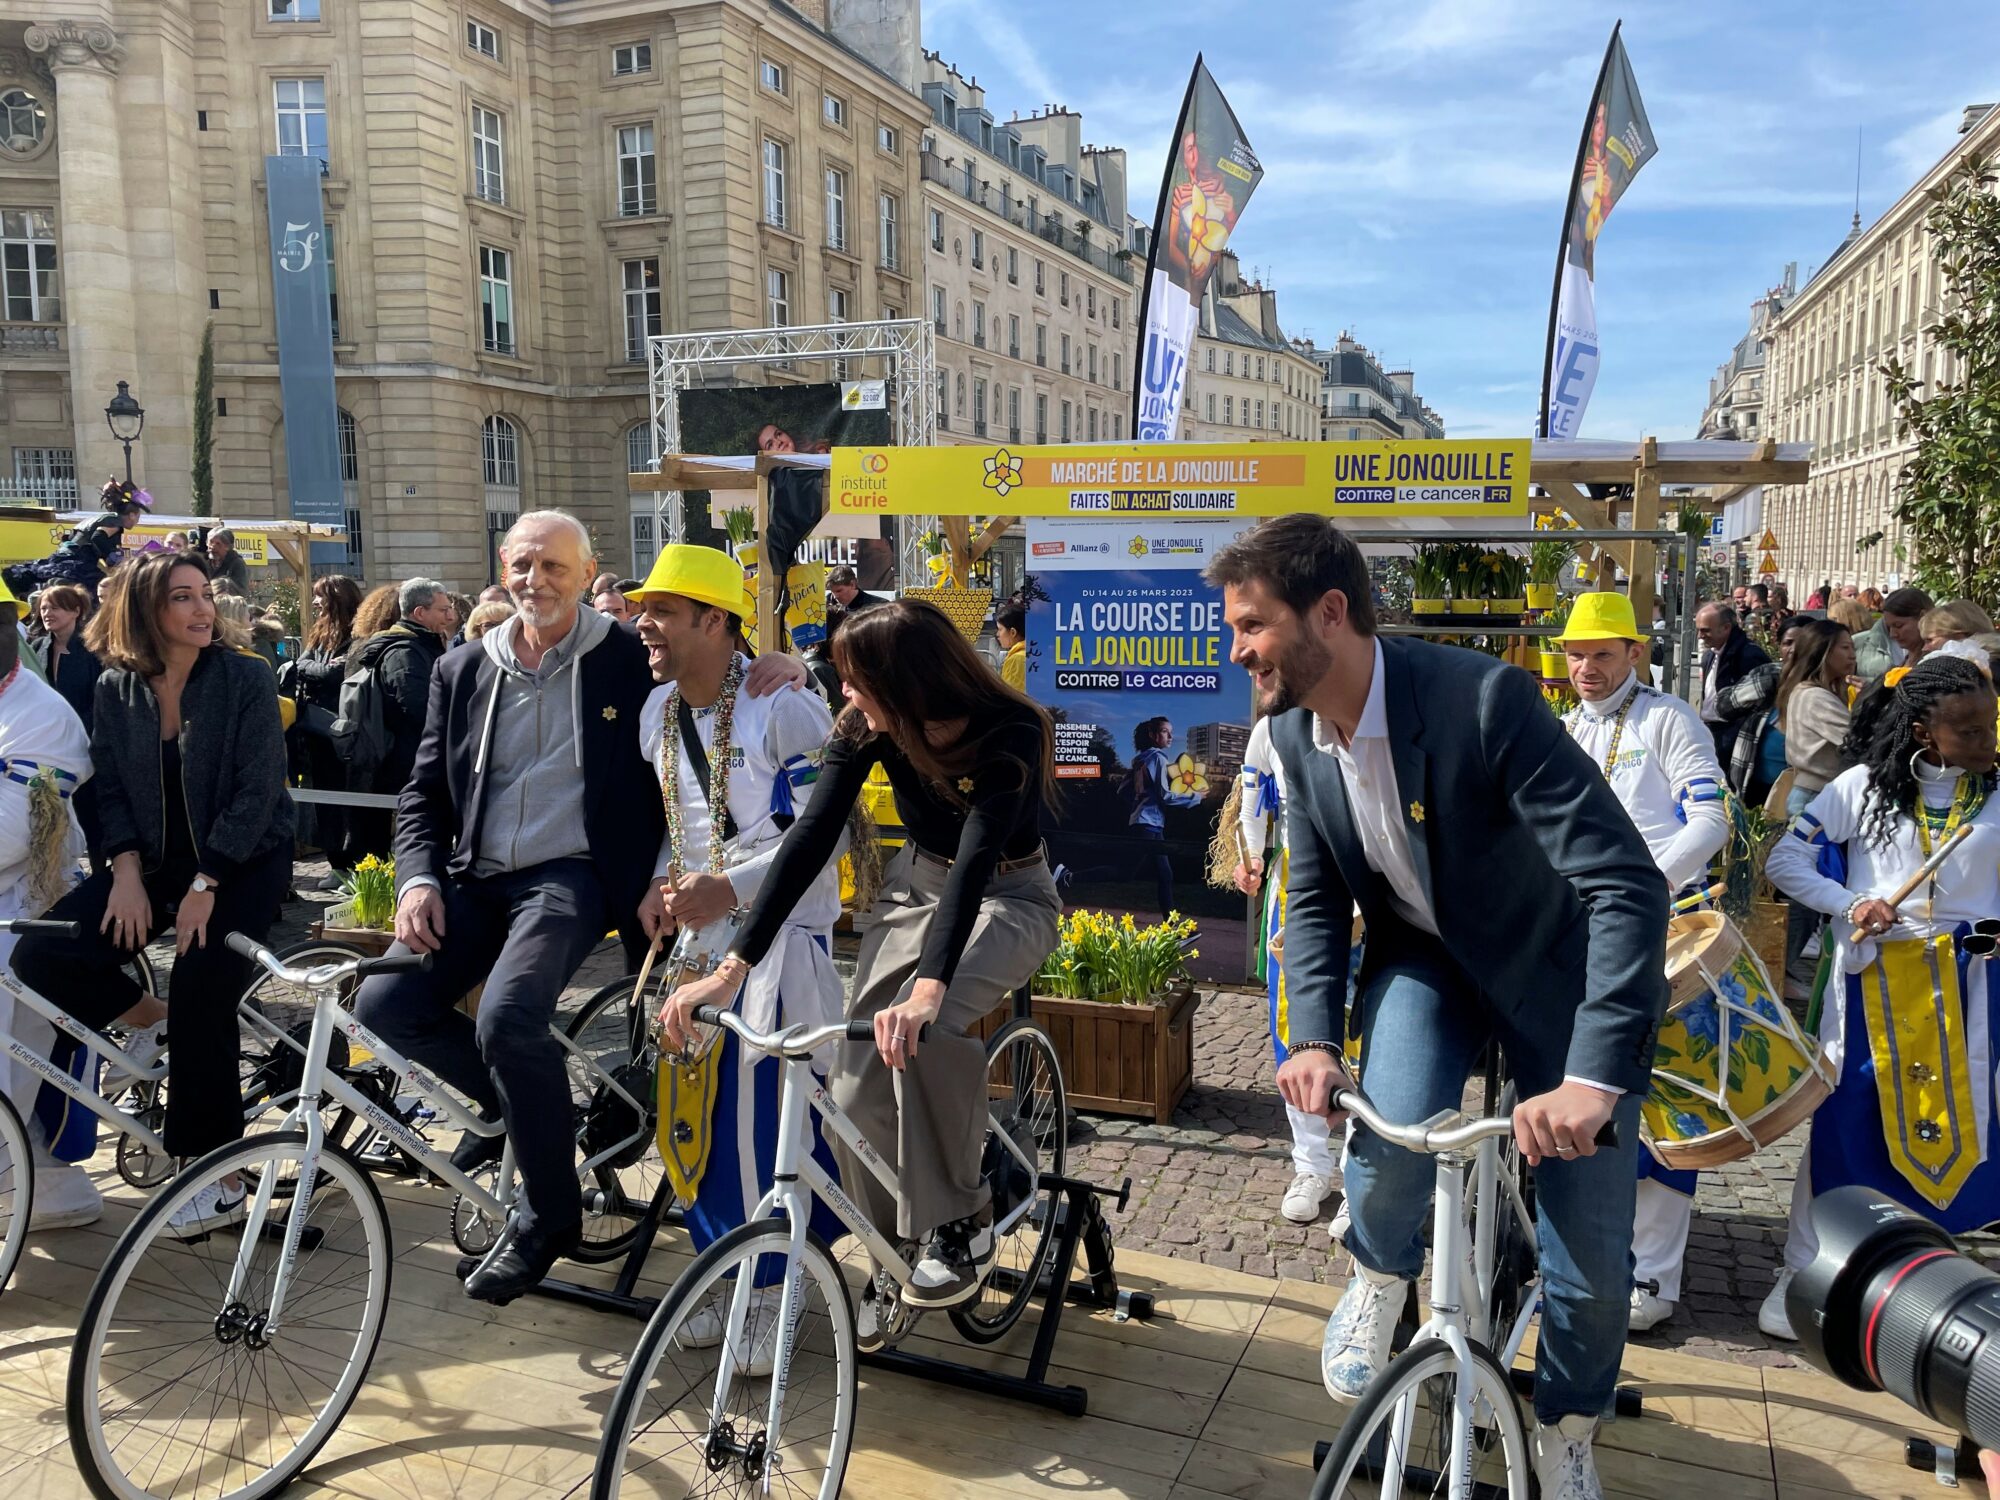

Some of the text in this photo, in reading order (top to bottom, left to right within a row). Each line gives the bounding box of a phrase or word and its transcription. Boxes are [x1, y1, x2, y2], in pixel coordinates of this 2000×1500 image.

[1051, 458, 1260, 483] MARCHÉ DE LA JONQUILLE
[1335, 452, 1514, 482] UNE JONQUILLE
[841, 474, 888, 490] institut
[840, 491, 888, 508] Curie
[1070, 492, 1236, 509] FAITES UN ACHAT SOLIDAIRE
[235, 539, 263, 551] QUILLE
[1070, 544, 1098, 553] Allianz
[1151, 538, 1203, 548] UNE JONQUILLE
[797, 538, 858, 565] QUILLE
[1082, 589, 1193, 597] DU 14 AU 26 MARS 2023
[1055, 602, 1221, 632] LA COURSE DE
[1055, 636, 1220, 667] LA JONQUILLE
[1055, 723, 1097, 731] ENSEMBLE
[1055, 731, 1094, 739] PORTONS
[1055, 739, 1090, 747] L'ESPOIR
[1055, 747, 1088, 755] CONTRE
[1065, 755, 1101, 763] CANCER.
[9, 1042, 80, 1094] #EnergieHumaine
[363, 1103, 430, 1157] #EnergieHumaine
[824, 1181, 874, 1238] #EnergieHumaine
